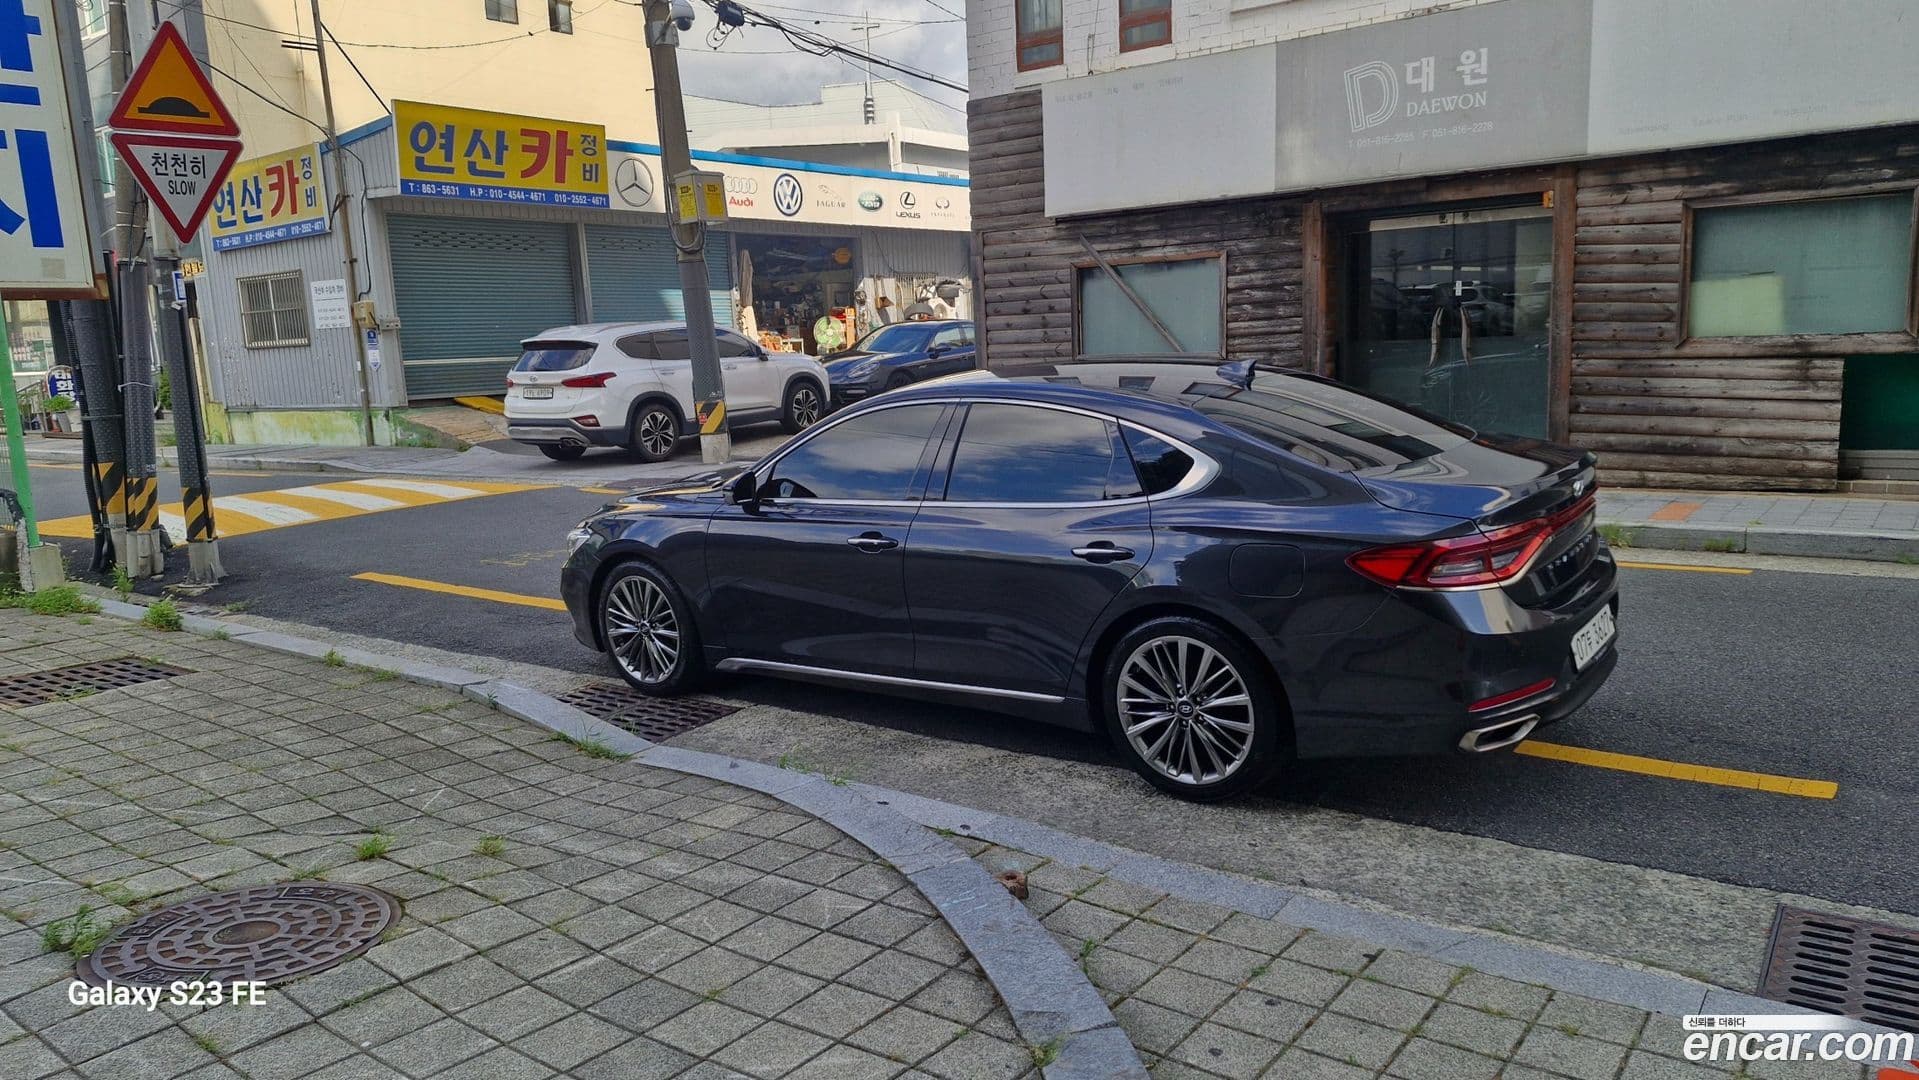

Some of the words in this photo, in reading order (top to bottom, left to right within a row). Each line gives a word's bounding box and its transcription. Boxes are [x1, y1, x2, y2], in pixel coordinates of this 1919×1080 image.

[1407, 91, 1487, 117] DAEWON
[410, 121, 574, 183] 연산카
[580, 134, 599, 183] 정비
[151, 152, 206, 179] 천천히
[168, 180, 196, 195] SLOW
[301, 157, 316, 207] 정비
[554, 193, 607, 206] 010-2552-4671
[729, 196, 754, 207] Audi
[816, 200, 847, 208] JAGUAR
[896, 210, 920, 219] LEXUS
